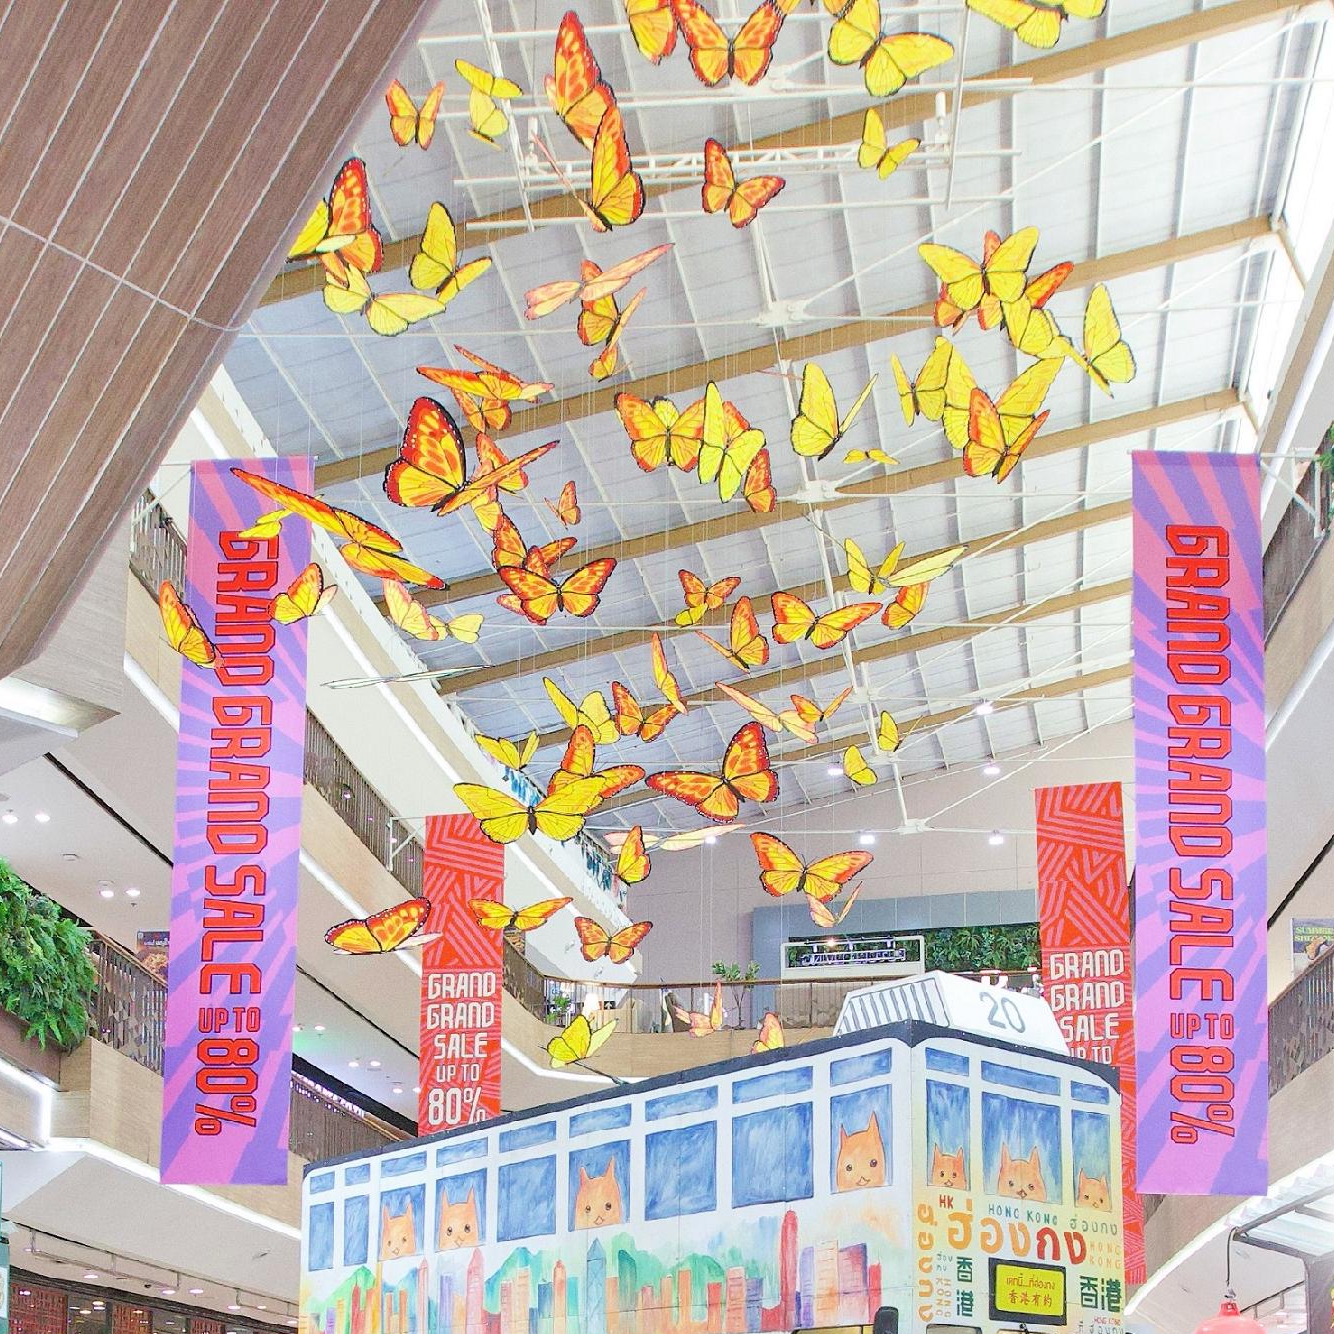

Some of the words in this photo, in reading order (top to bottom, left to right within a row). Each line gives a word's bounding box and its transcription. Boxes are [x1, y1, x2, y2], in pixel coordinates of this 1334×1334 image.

[217, 530, 279, 686] GRAND
[1166, 524, 1231, 684] GRAND
[208, 696, 273, 855] GRAND
[1166, 696, 1232, 857] GRAND
[199, 865, 267, 994] SALE
[1169, 870, 1234, 1001] SALE
[1049, 949, 1124, 980] GRAND
[427, 971, 496, 1000] GRAND
[1050, 981, 1125, 1012] GRAND
[198, 1007, 229, 1033] UP
[233, 1007, 261, 1033] TO
[426, 1001, 495, 1030] GRAND
[979, 991, 1026, 1033] 20
[1059, 1012, 1120, 1042] SALE
[1170, 1012, 1201, 1040] UP
[1204, 1013, 1234, 1040] TO
[433, 1032, 488, 1059] SALE
[195, 1038, 260, 1136] 80%
[436, 1065, 456, 1083] UP
[461, 1063, 480, 1082] TO
[427, 1087, 486, 1126] 80%
[1170, 1045, 1235, 1145] 80%
[939, 1194, 954, 1210] HK
[988, 1203, 1019, 1220] HONG
[1027, 1210, 1058, 1226] KONG
[947, 1198, 1087, 1265] ฮ่องกง
[1070, 1214, 1118, 1236] ฮ่องกง
[1089, 1241, 1121, 1256] HONG
[1089, 1256, 1121, 1270] KONG
[956, 1256, 974, 1318] 香港
[1079, 1275, 1122, 1313] 香港
